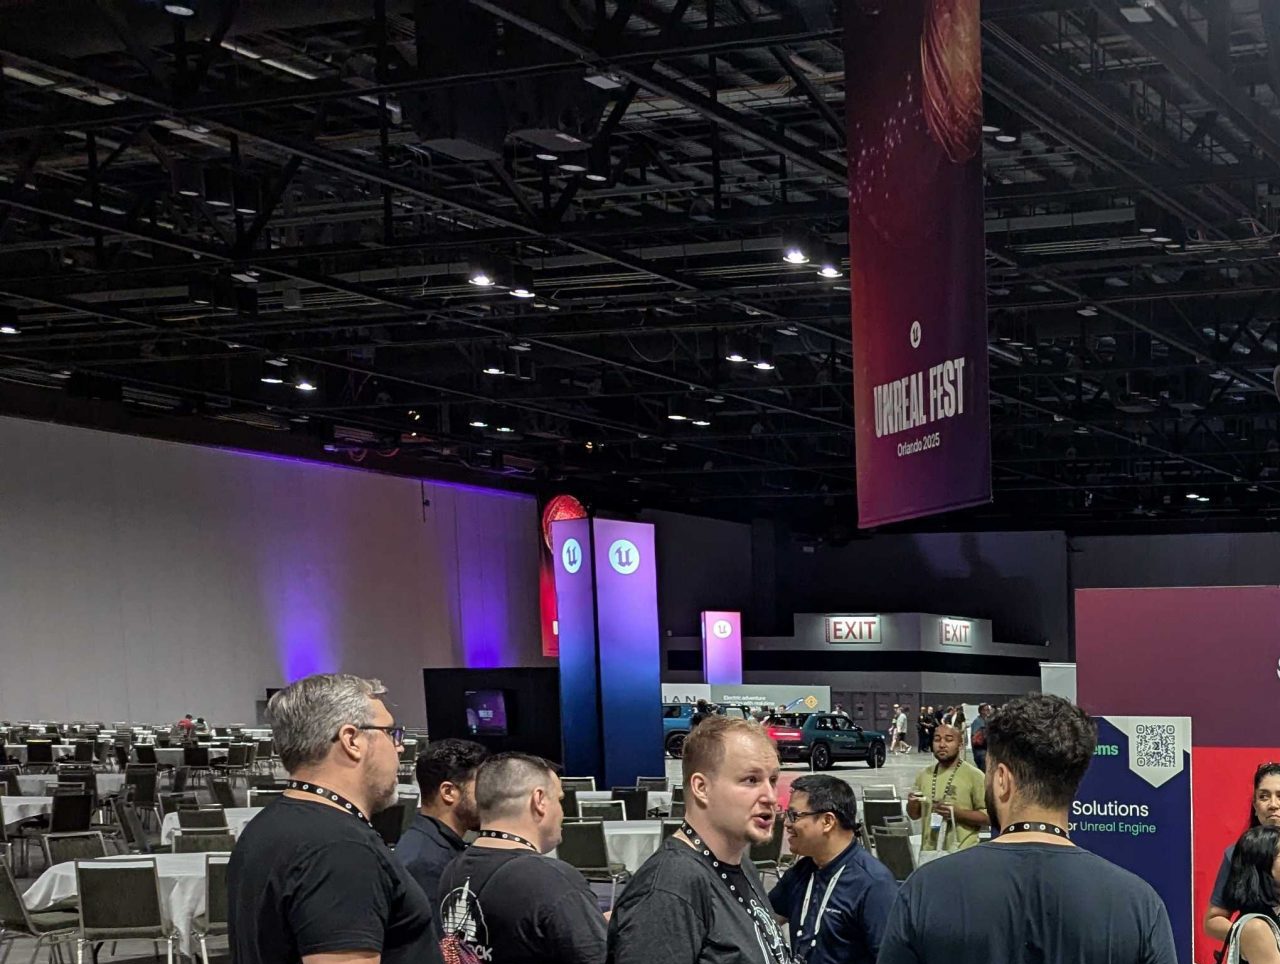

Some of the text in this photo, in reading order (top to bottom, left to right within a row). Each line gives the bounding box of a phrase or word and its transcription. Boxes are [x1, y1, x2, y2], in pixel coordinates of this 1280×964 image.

[874, 357, 965, 438] UNREAL FEST
[897, 432, 940, 456] Orlando 2025
[833, 621, 876, 640] EXIT
[944, 623, 969, 643] EXIT
[1072, 800, 1149, 817] Solutions
[1080, 821, 1116, 832] Unreal
[1118, 822, 1157, 835] Engine
